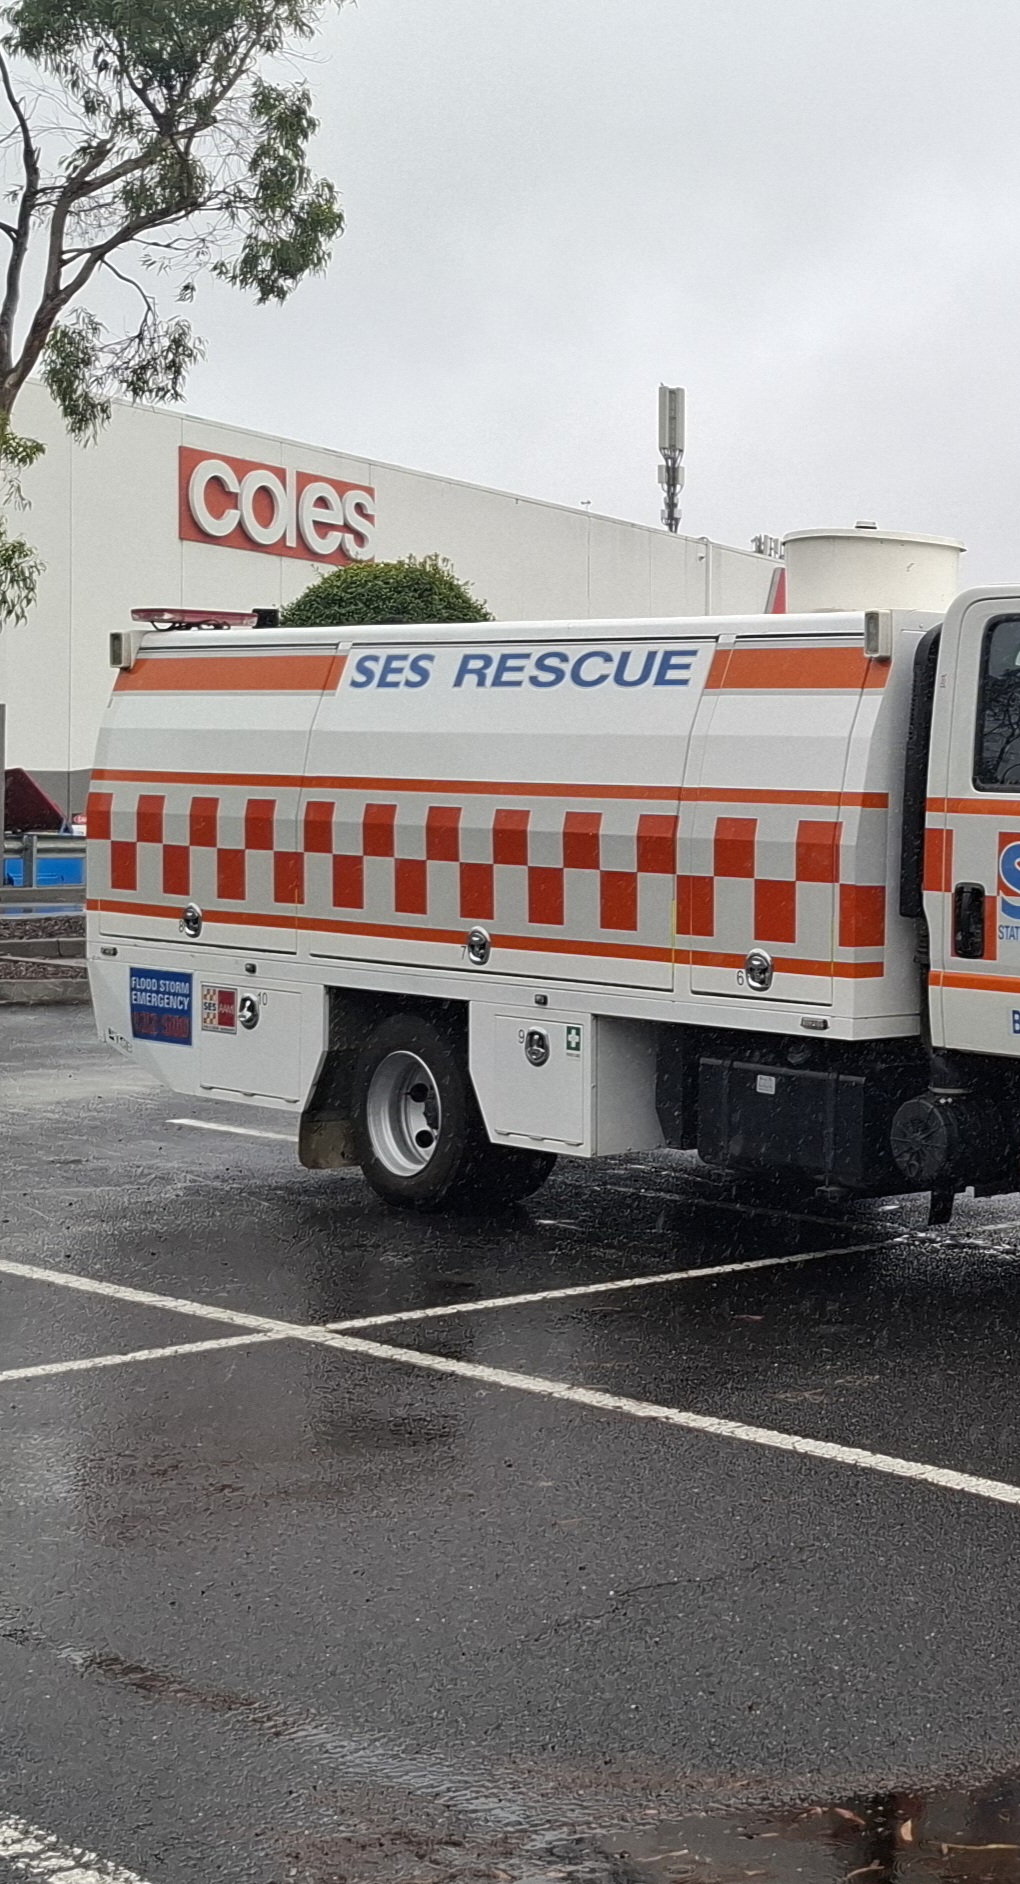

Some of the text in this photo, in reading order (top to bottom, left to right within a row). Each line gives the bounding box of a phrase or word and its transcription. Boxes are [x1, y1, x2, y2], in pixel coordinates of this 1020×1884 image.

[188, 459, 376, 562] coles
[350, 649, 698, 689] SES RESCUE
[460, 945, 467, 960] 7
[131, 976, 190, 995] FLOOD STORM
[736, 969, 744, 986] 6
[131, 990, 190, 1010] EMERGENCY
[203, 1001, 217, 1012] SES
[518, 1029, 525, 1044] 9
